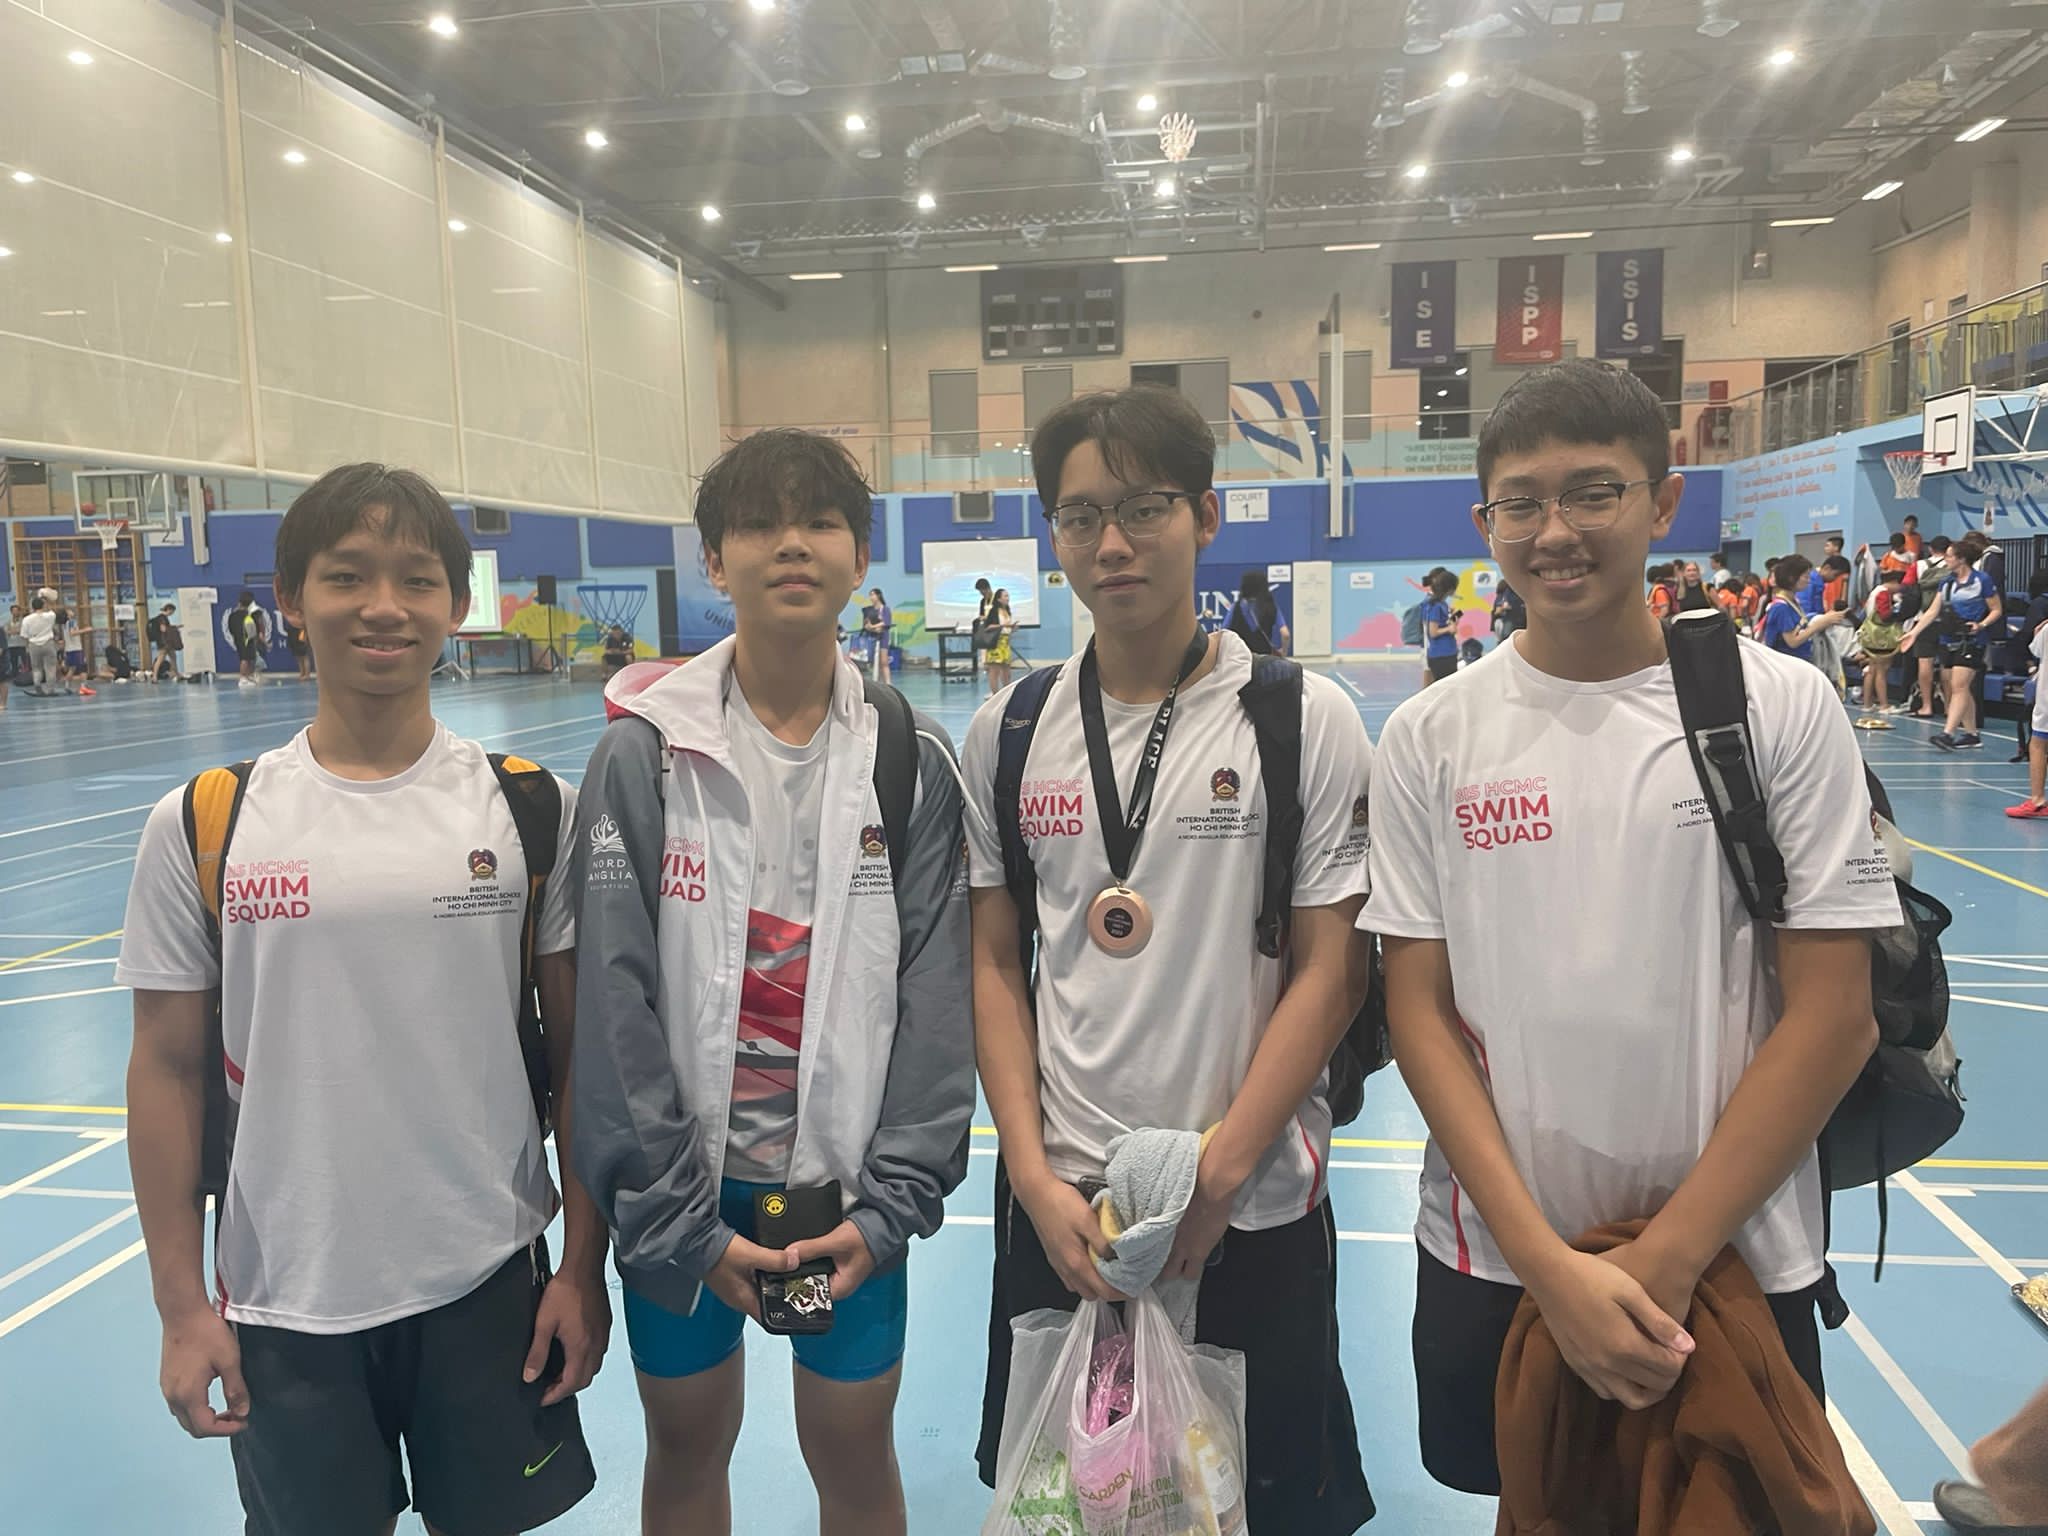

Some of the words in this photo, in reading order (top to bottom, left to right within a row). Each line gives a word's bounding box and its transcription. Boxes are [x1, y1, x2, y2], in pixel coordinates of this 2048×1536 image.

[1522, 265, 1539, 345] ISPP
[1622, 259, 1639, 341] SSIS
[1416, 271, 1432, 348] ISE
[1230, 492, 1265, 502] COURT
[1242, 502, 1249, 518] 1
[1033, 777, 1083, 794] HCMC
[1484, 776, 1547, 797] HCMC
[1018, 794, 1083, 817] WIM
[1209, 807, 1241, 815] BRITISH
[1455, 793, 1550, 828] SWIM
[1691, 807, 1704, 816] HO
[1176, 815, 1240, 823] INTERNATIONAL
[1463, 822, 1553, 850] SQUAD
[249, 859, 309, 877] HCMC
[592, 858, 627, 869] NORD
[1858, 867, 1870, 875] HO
[587, 871, 634, 882] ANGLIA
[225, 875, 309, 903] SWIM
[469, 884, 499, 893] BRITISH
[432, 893, 497, 904] INTERNATIONAL
[448, 903, 461, 911] HO
[462, 901, 477, 910] CHI
[478, 900, 498, 908] MINH
[228, 901, 310, 924] SQUAD
